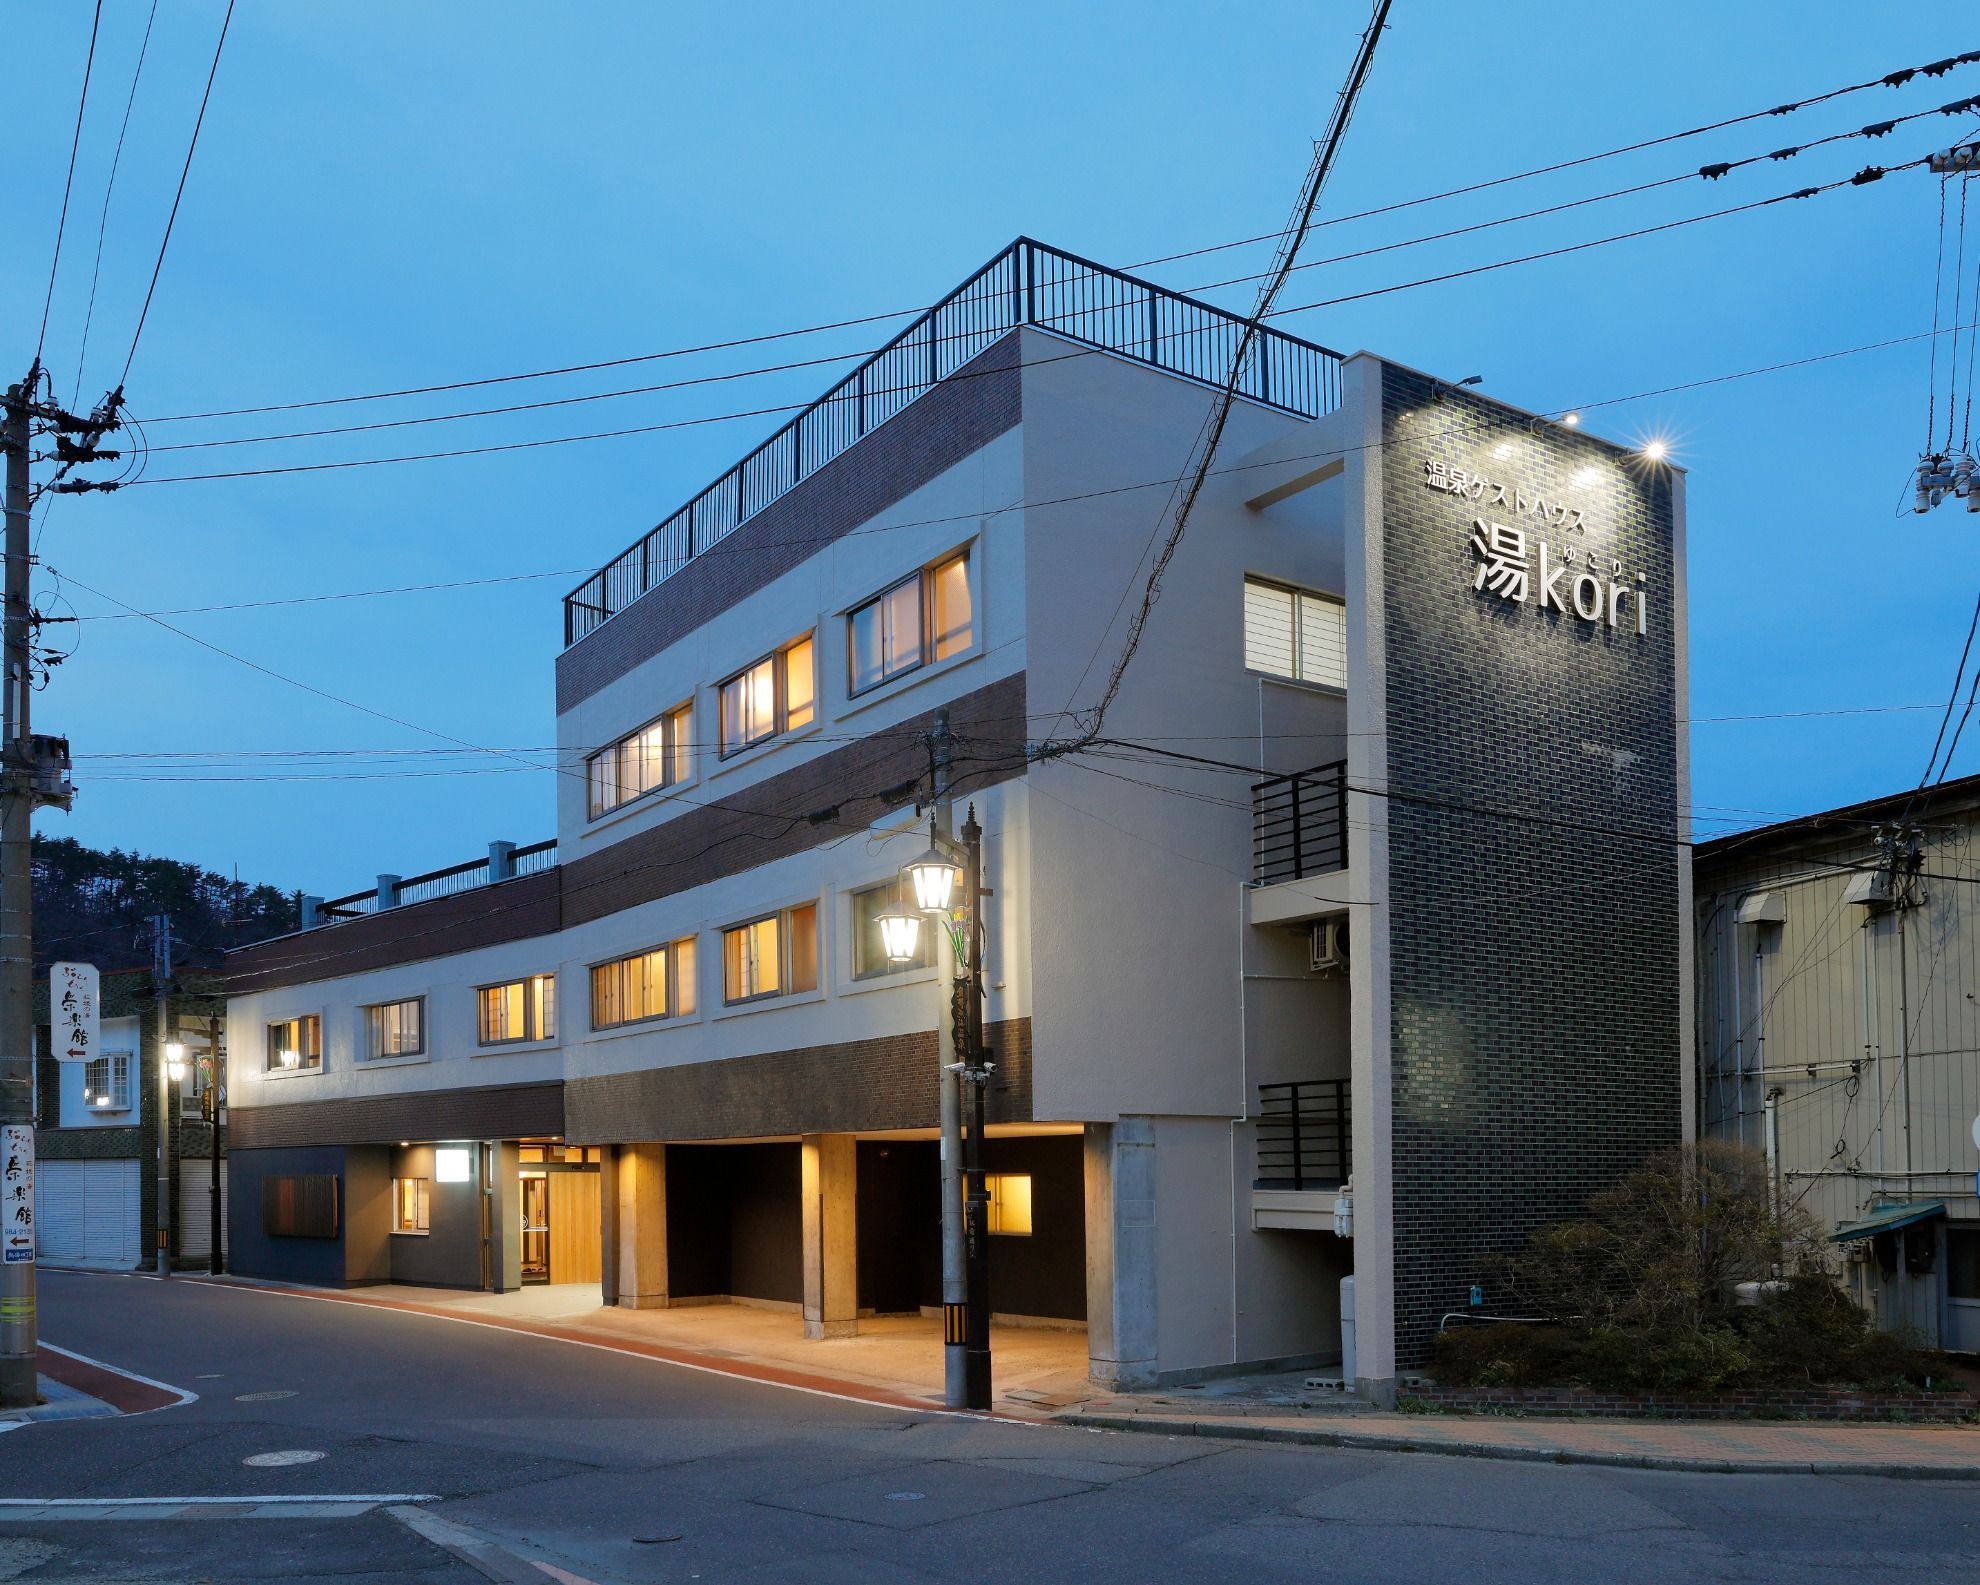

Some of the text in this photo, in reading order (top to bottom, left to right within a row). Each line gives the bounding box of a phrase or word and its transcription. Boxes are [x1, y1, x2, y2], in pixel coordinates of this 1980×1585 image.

[1425, 459, 1588, 533] 温泉ゲストハウス
[1563, 544, 1622, 577] ゆこり
